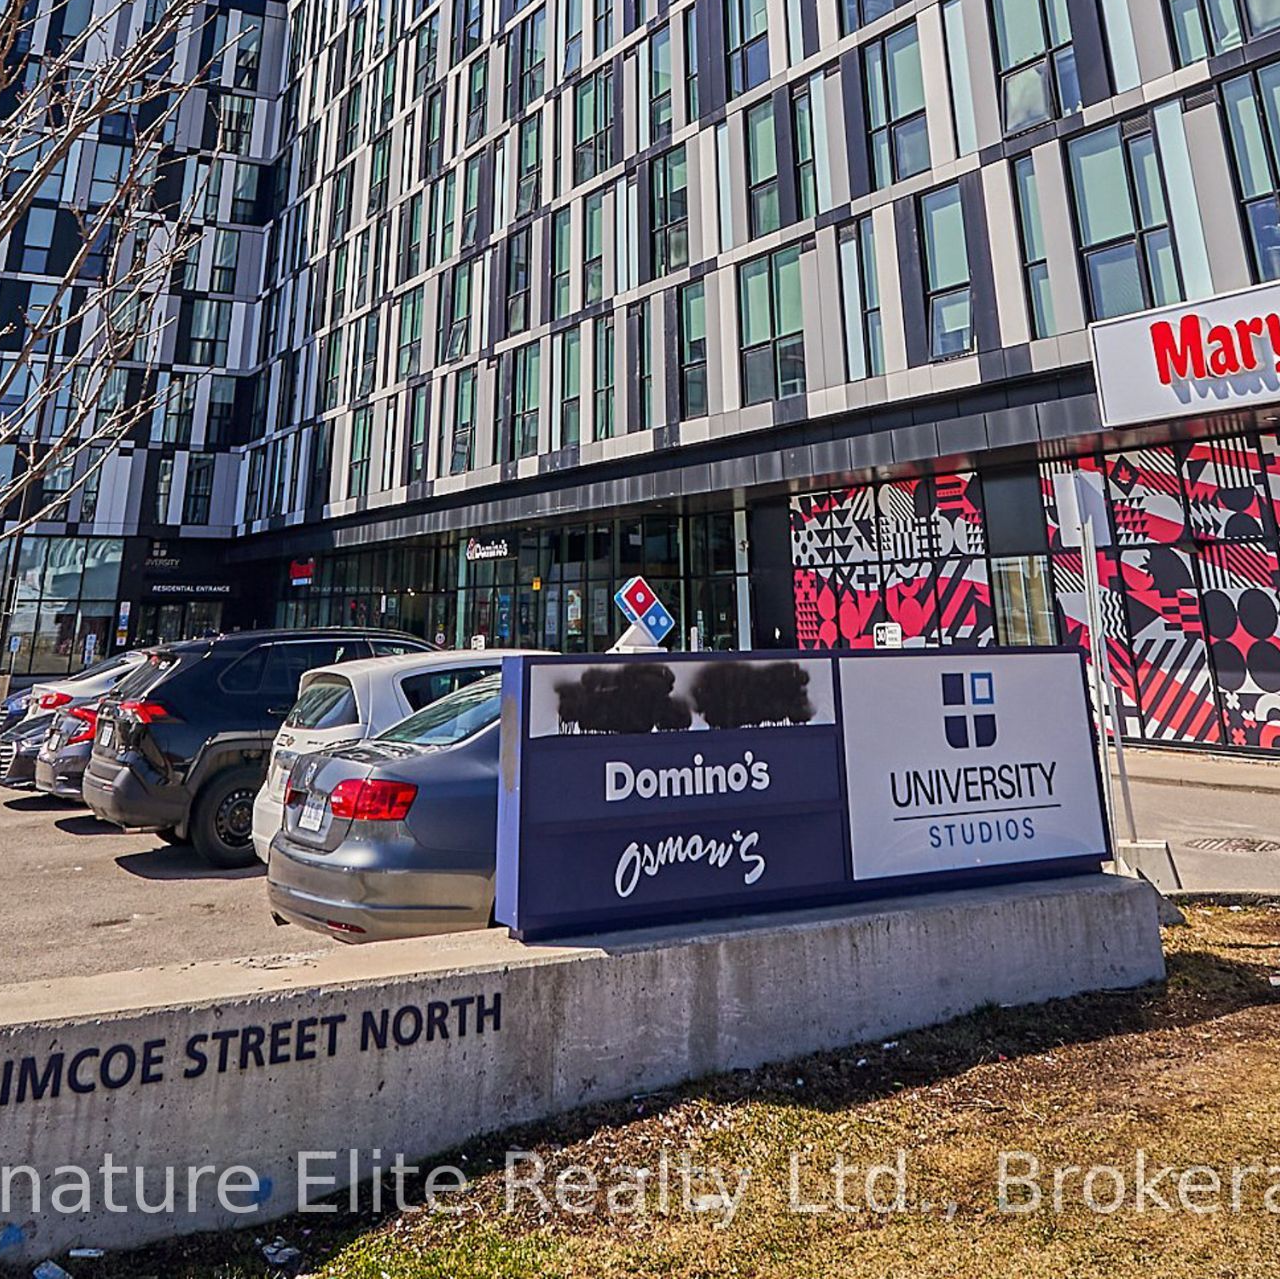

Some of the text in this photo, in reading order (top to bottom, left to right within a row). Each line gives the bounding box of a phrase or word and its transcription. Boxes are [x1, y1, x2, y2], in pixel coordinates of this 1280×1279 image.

[474, 539, 508, 559] Domino's
[152, 585, 230, 593] RESIDENTIAL ENTRANCE
[605, 750, 771, 802] Domino's
[889, 761, 1057, 808] UNIVERSITY
[928, 817, 1036, 849] STUDIOS
[183, 1013, 347, 1080] STREET
[359, 991, 503, 1053] NORTH
